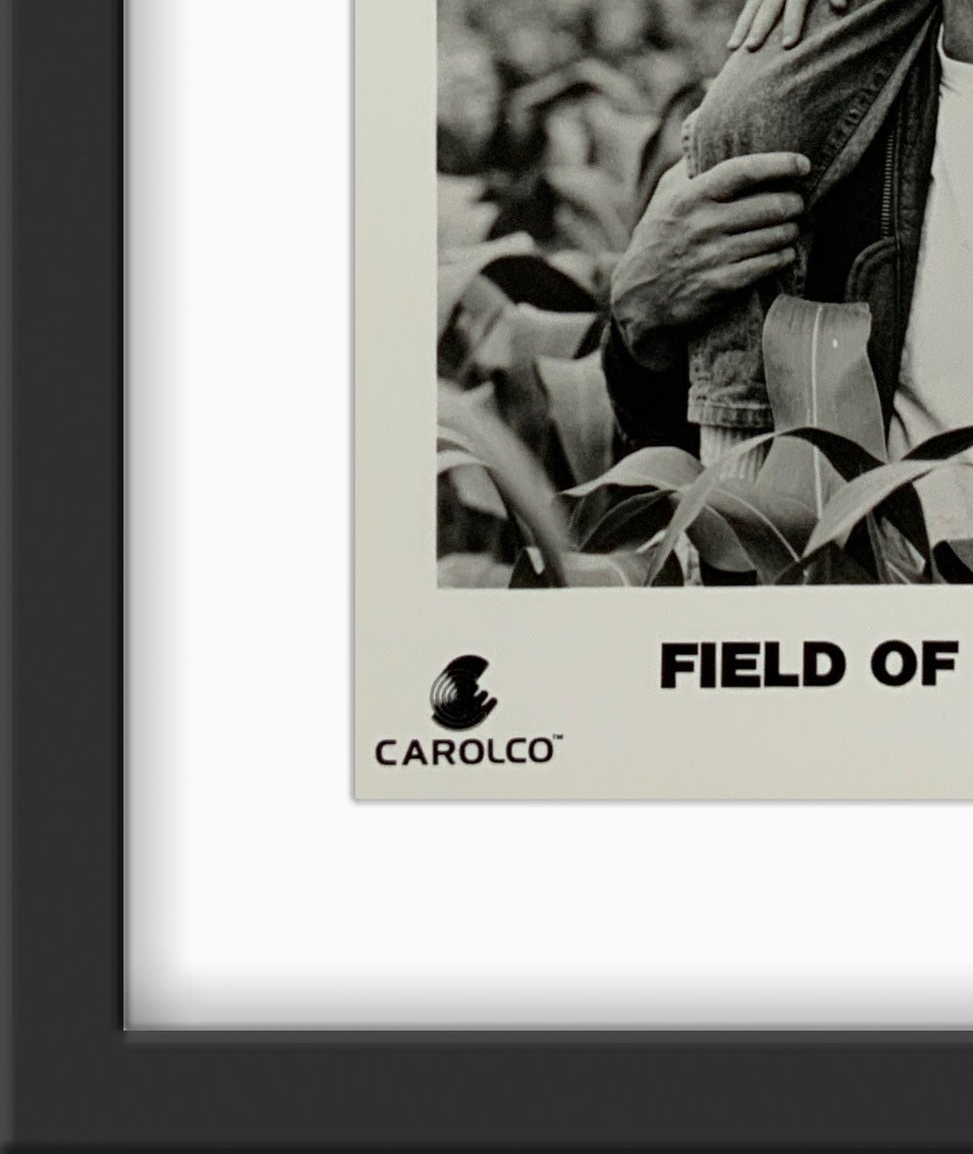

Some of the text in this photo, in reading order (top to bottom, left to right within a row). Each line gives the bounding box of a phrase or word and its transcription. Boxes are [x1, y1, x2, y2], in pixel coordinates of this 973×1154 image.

[660, 641, 847, 689] FIELD
[870, 639, 960, 688] OF
[375, 737, 555, 766] CAROLCO
